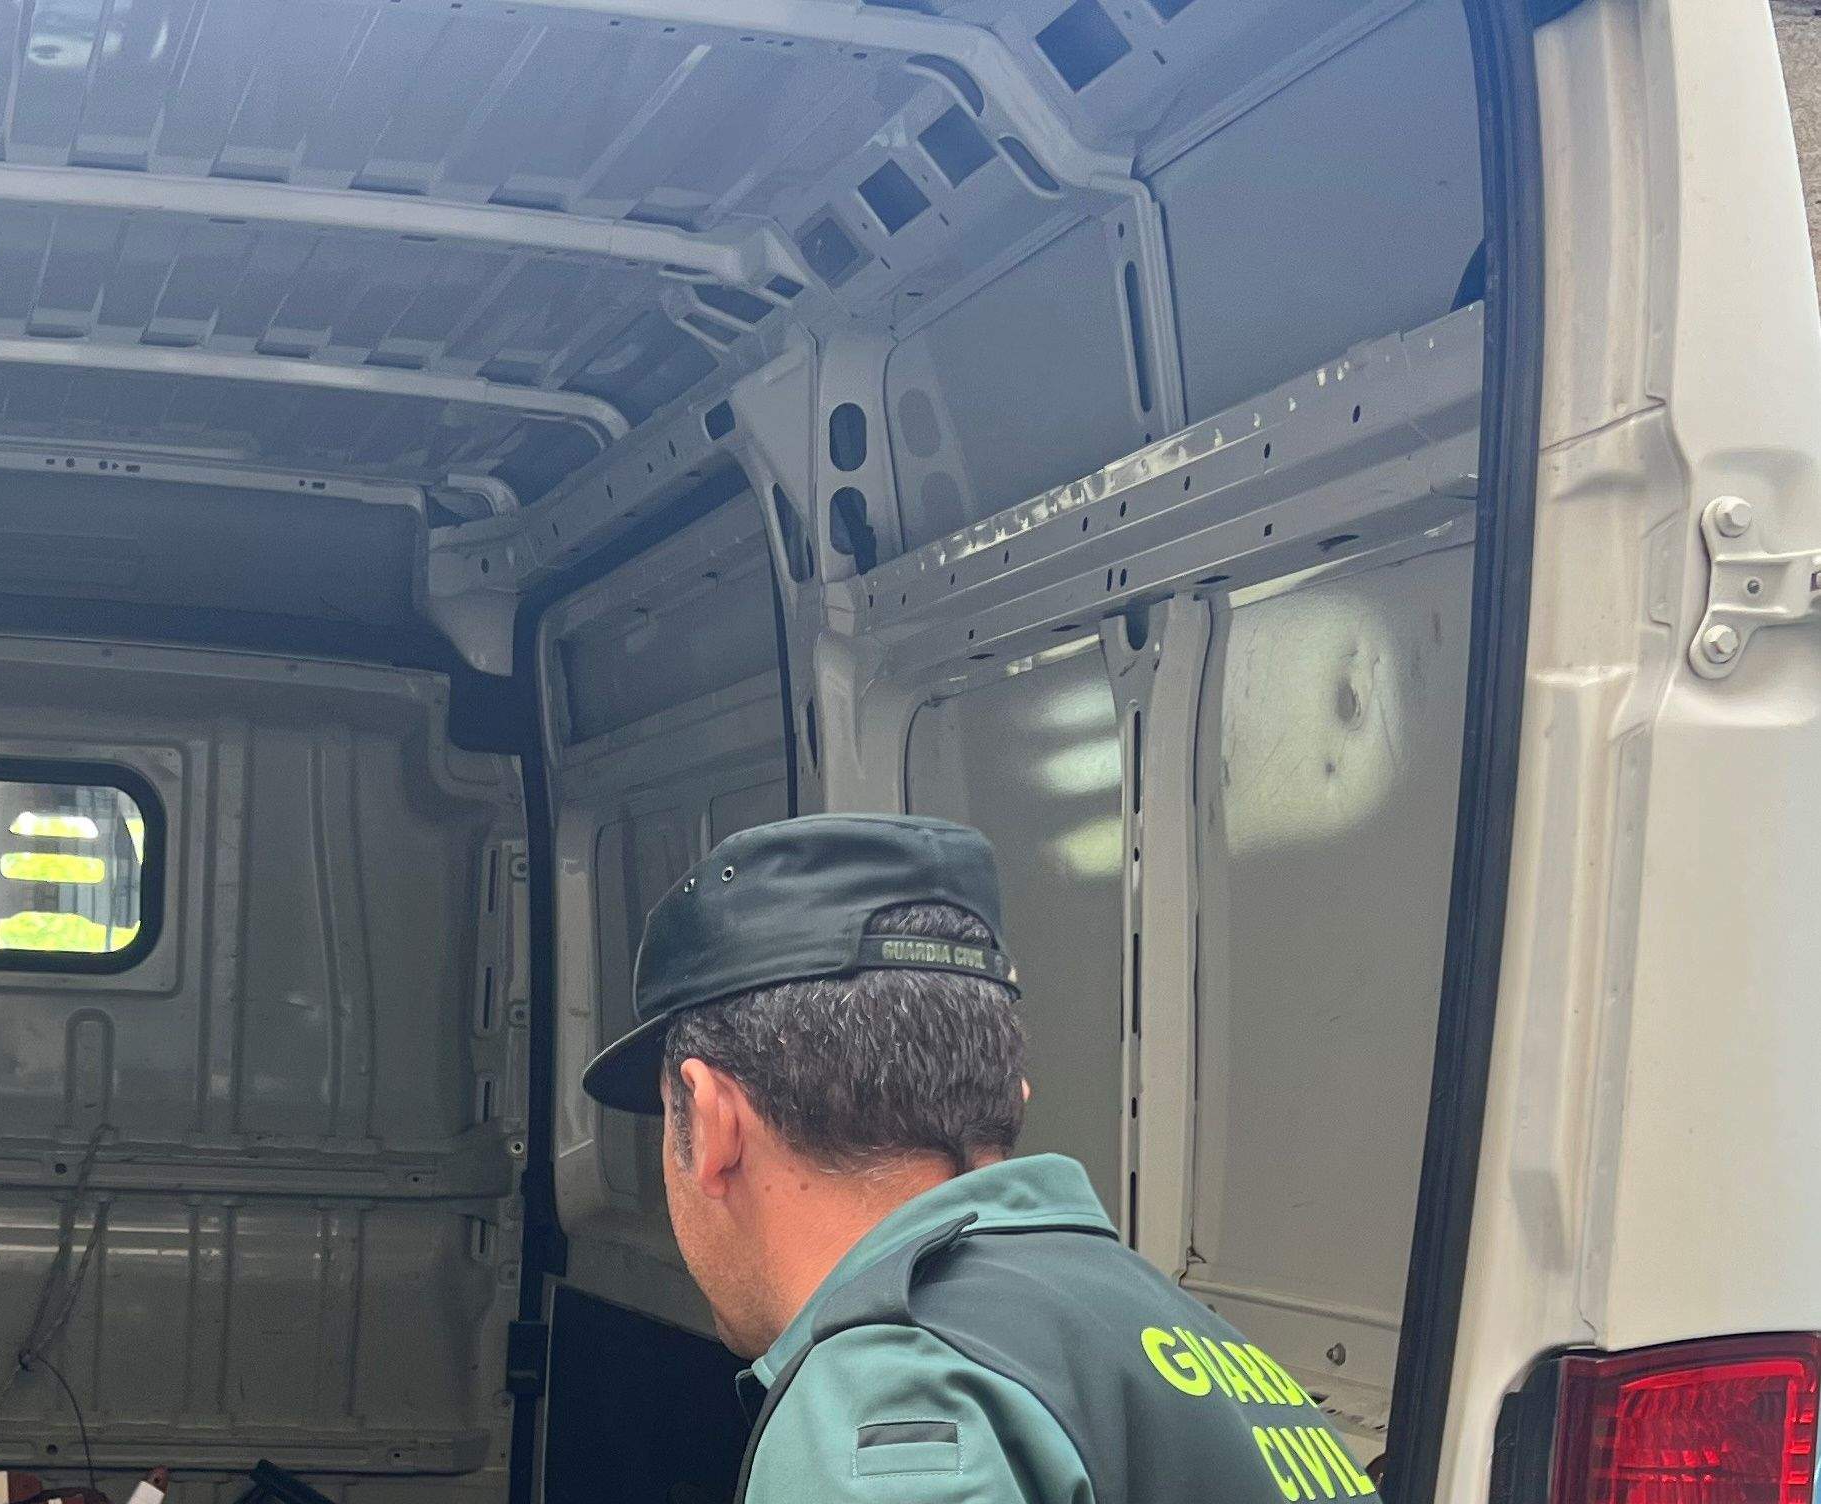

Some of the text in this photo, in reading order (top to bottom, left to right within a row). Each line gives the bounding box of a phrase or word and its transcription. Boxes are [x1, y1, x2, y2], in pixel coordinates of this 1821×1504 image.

[881, 940, 987, 970] GUARDIA CIVIL
[1251, 1425, 1376, 1502] CIVIL
